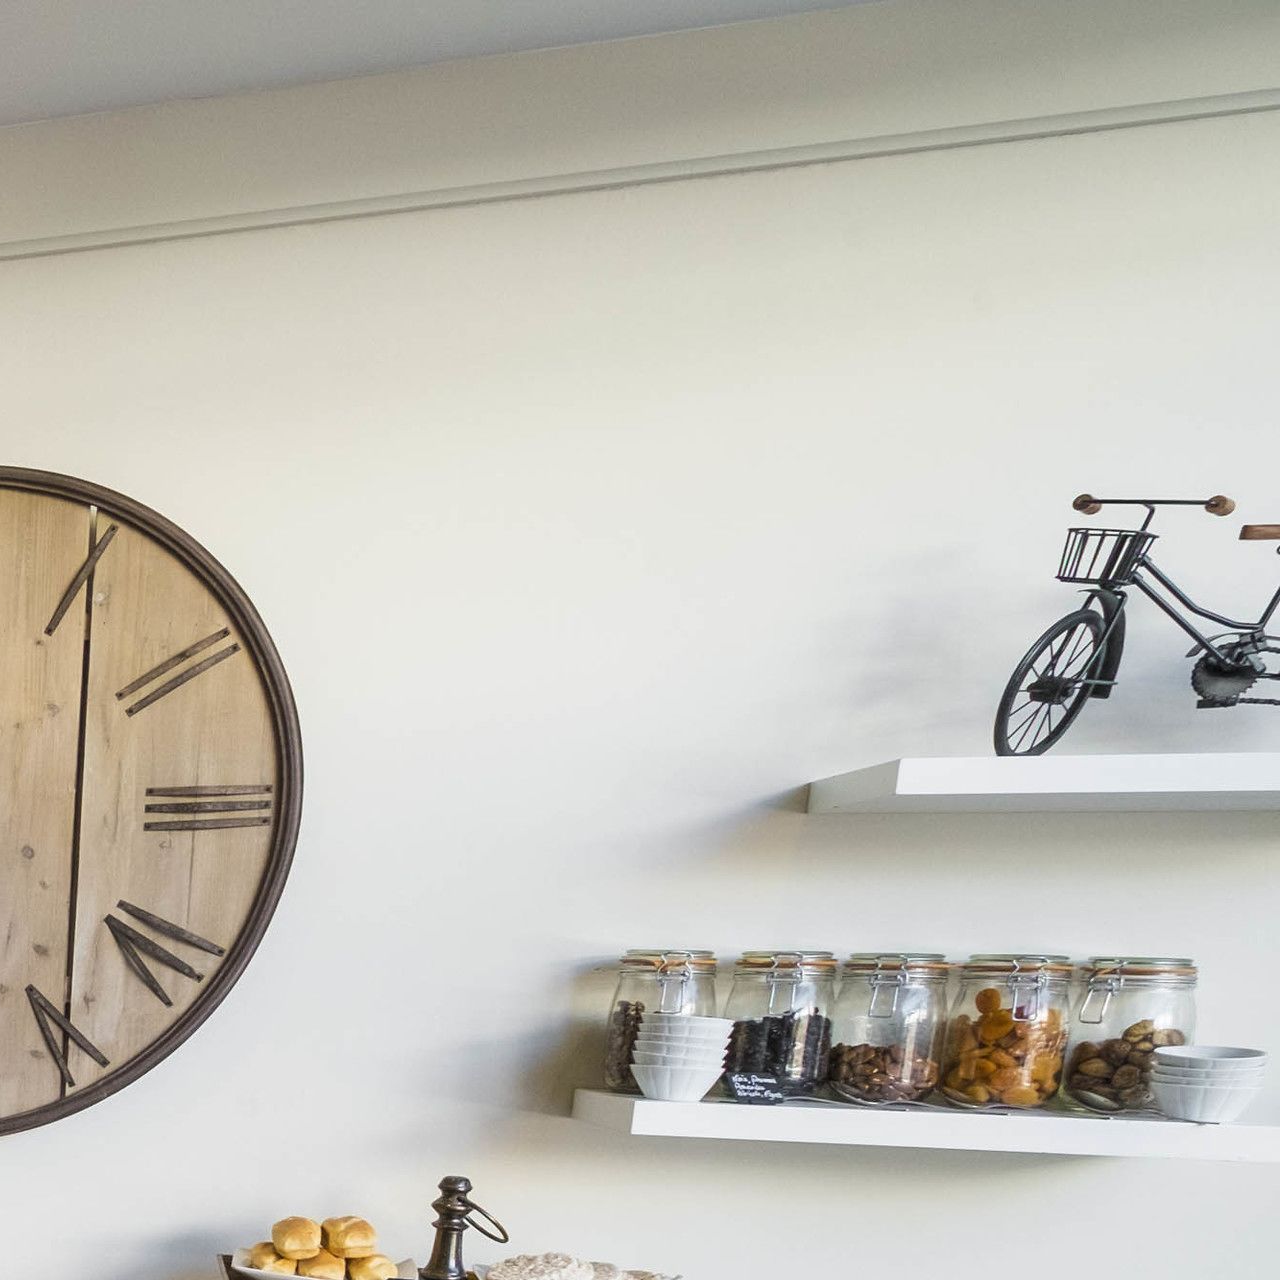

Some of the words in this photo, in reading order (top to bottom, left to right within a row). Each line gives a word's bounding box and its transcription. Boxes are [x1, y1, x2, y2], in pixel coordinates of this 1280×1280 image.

[115, 627, 241, 718] II
[143, 784, 273, 832] III
[25, 984, 110, 1088] V
